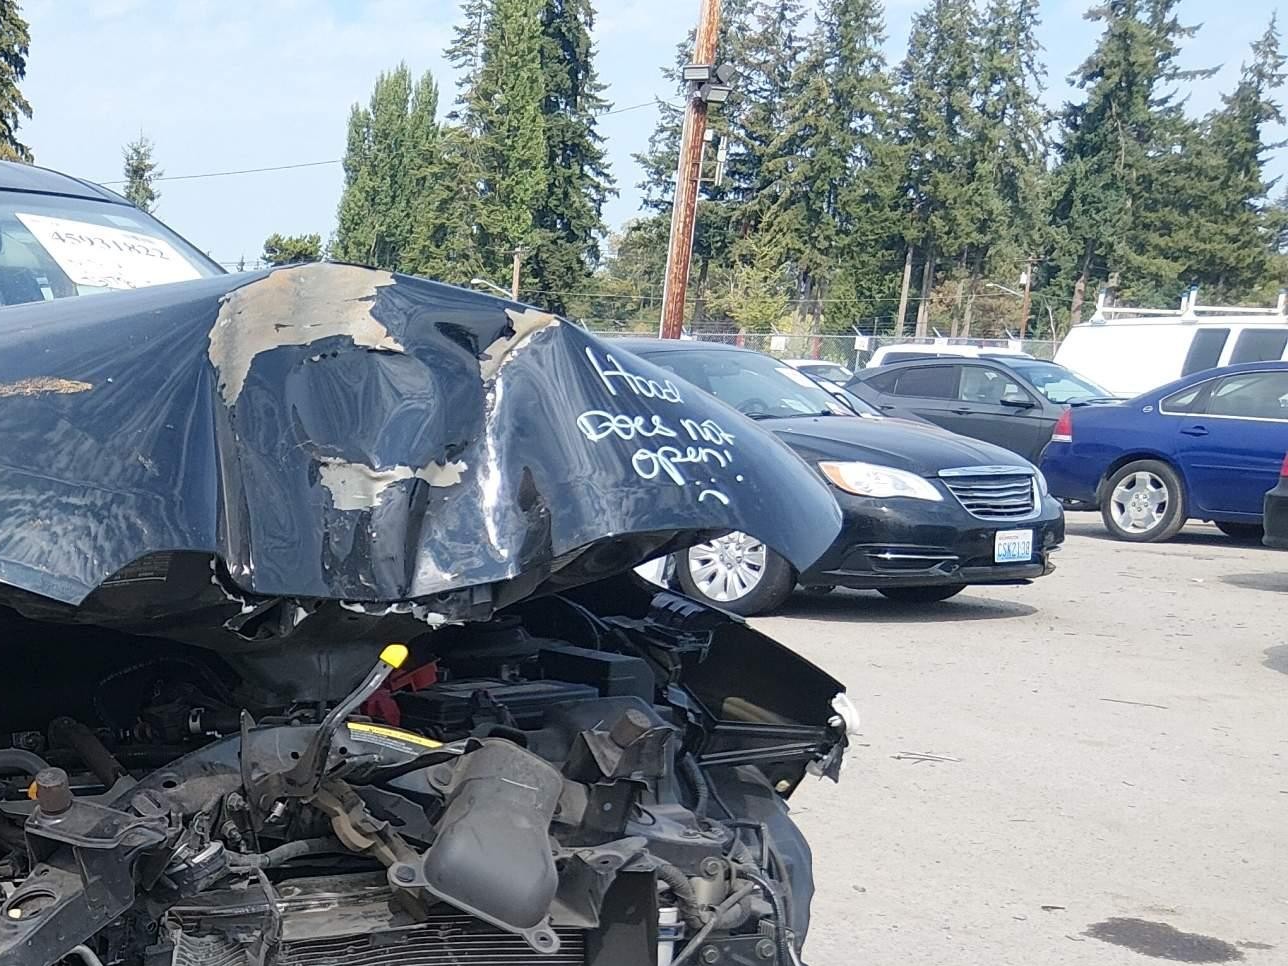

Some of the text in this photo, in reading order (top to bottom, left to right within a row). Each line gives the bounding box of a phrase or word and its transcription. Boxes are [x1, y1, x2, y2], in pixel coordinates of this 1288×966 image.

[50, 230, 170, 261] 45931822
[584, 346, 685, 404] Hood
[576, 409, 737, 446] Does not
